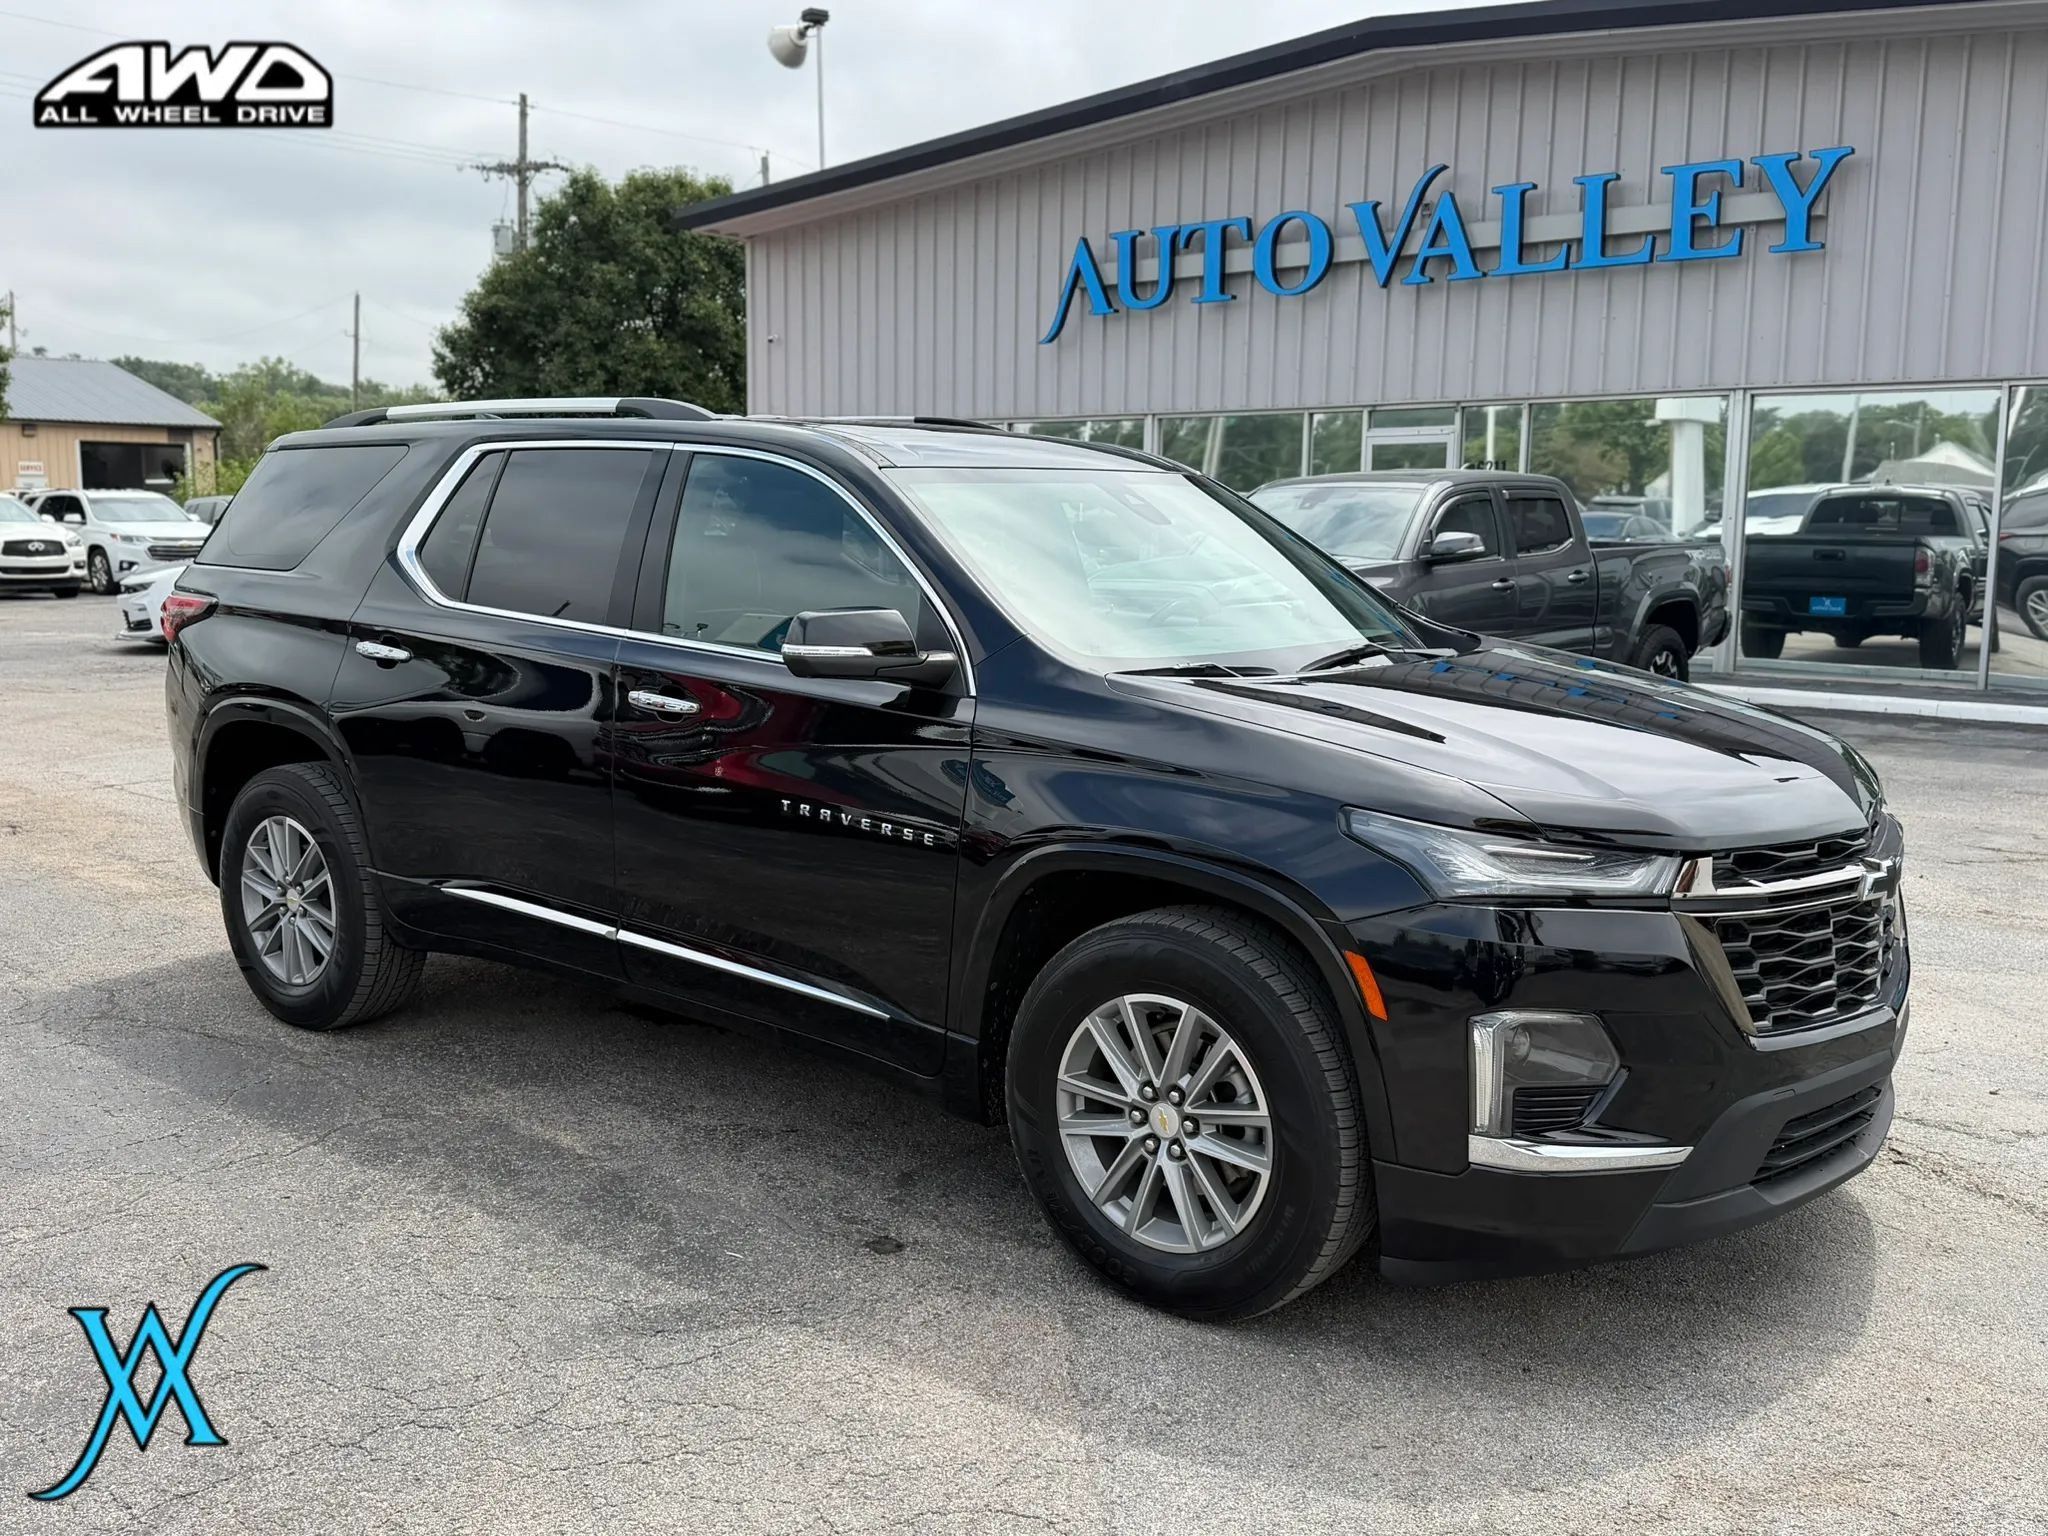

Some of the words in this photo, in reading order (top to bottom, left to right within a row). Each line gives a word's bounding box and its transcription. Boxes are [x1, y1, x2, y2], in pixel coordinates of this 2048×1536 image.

[1038, 210, 1334, 345] AUTO
[1344, 145, 1856, 289] VALLEY
[780, 799, 935, 846] TRAVERSE
